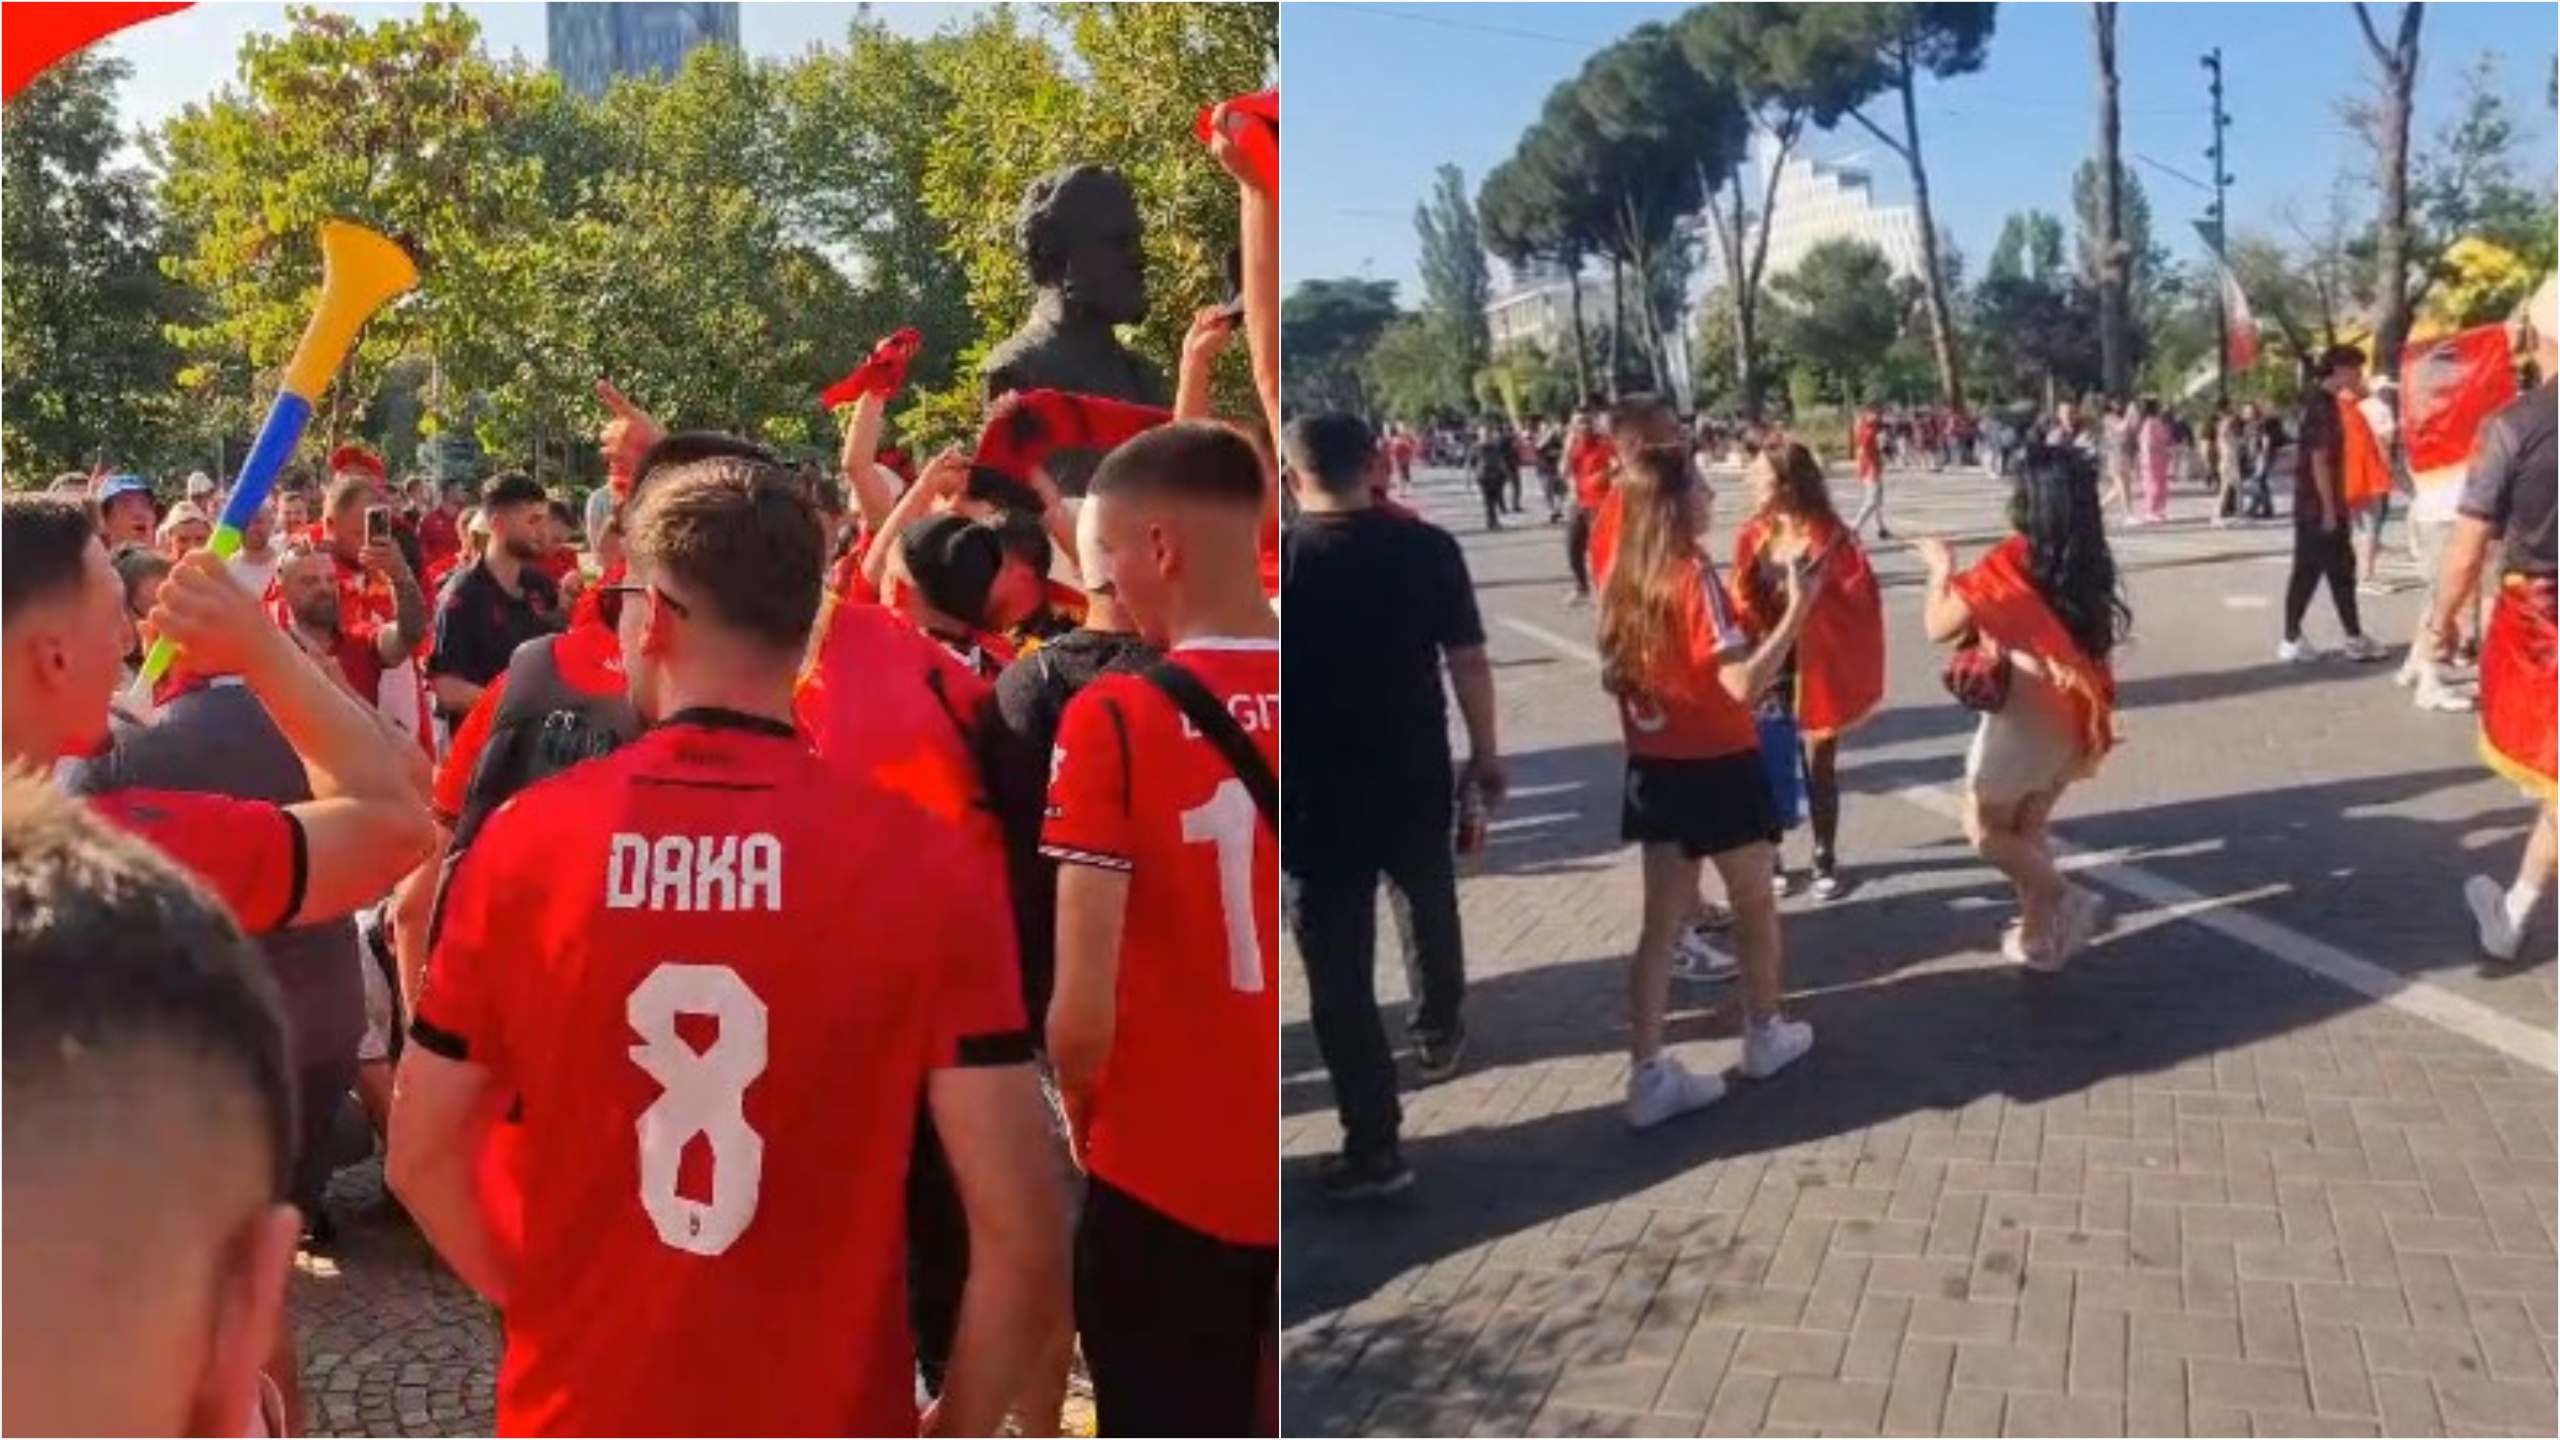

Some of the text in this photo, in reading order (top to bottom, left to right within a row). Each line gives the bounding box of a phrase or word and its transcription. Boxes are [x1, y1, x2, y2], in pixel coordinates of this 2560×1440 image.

[606, 832, 782, 911] DAKA
[1180, 777, 1265, 991] 1
[625, 962, 768, 1256] 8
